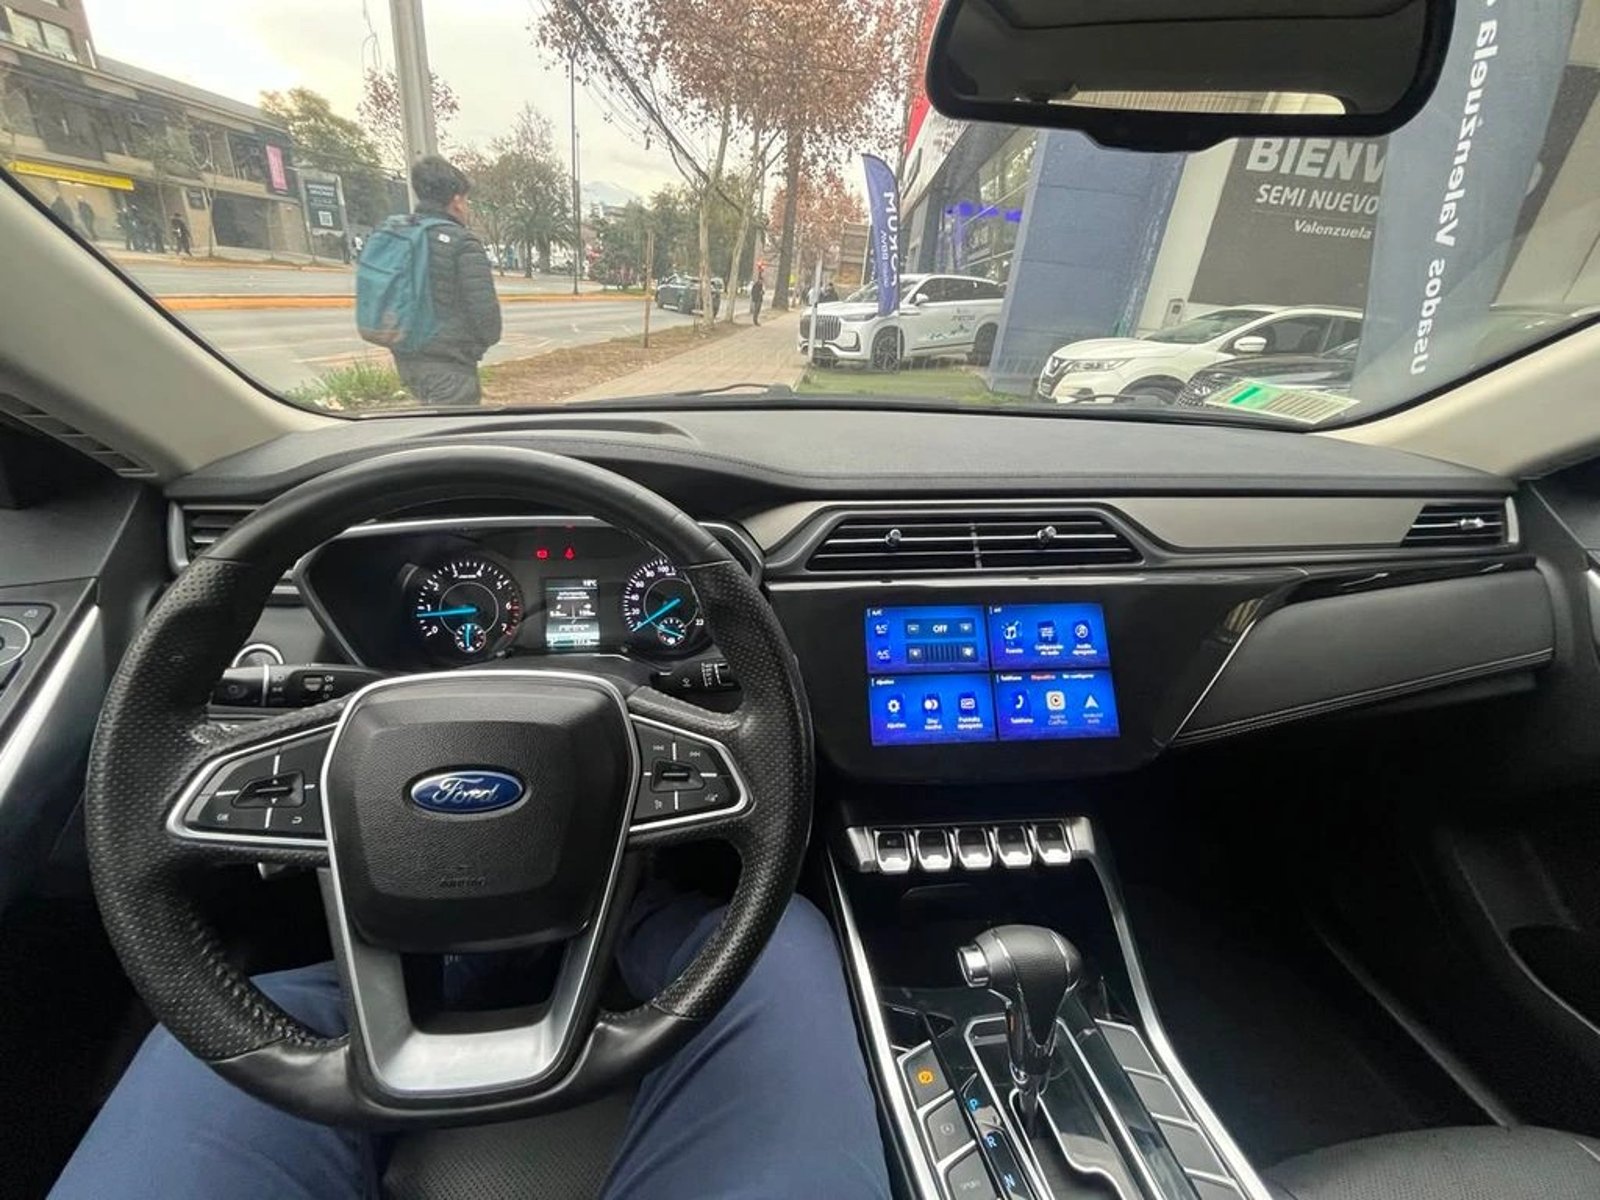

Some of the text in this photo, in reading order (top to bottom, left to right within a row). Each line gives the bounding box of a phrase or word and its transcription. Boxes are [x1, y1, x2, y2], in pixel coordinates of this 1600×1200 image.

[1255, 183, 1306, 208] SEMI
[1294, 218, 1372, 240] Valenzuela
[432, 777, 500, 803] Ford
[985, 1136, 997, 1148] R
